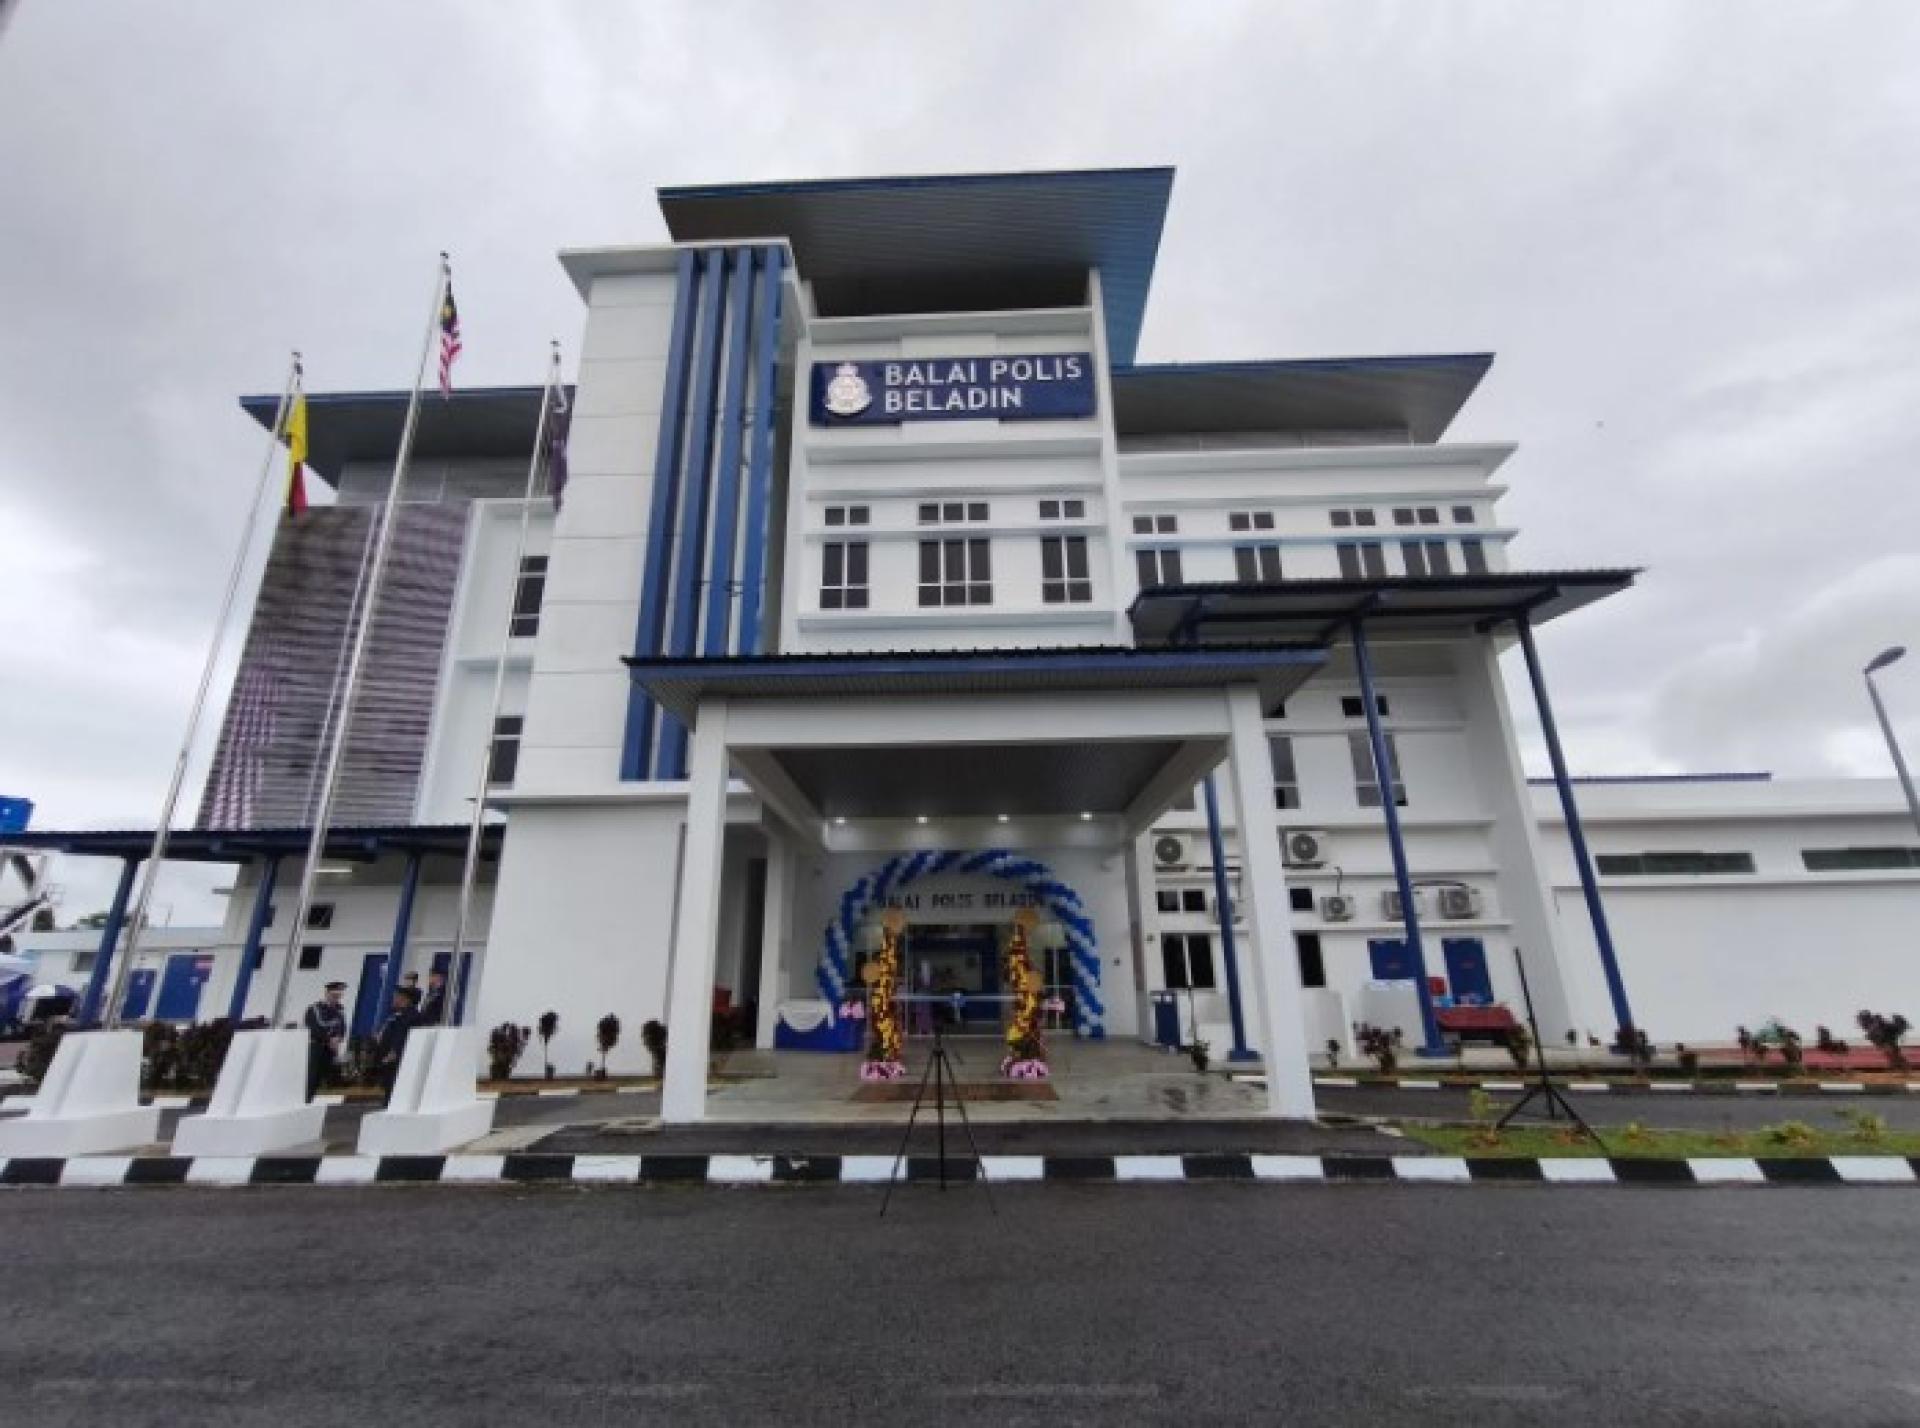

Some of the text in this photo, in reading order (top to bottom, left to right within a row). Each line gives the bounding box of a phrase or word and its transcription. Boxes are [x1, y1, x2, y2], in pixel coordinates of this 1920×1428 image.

[885, 357, 1082, 386] BALAI POLIS
[885, 387, 1022, 413] BELADIN
